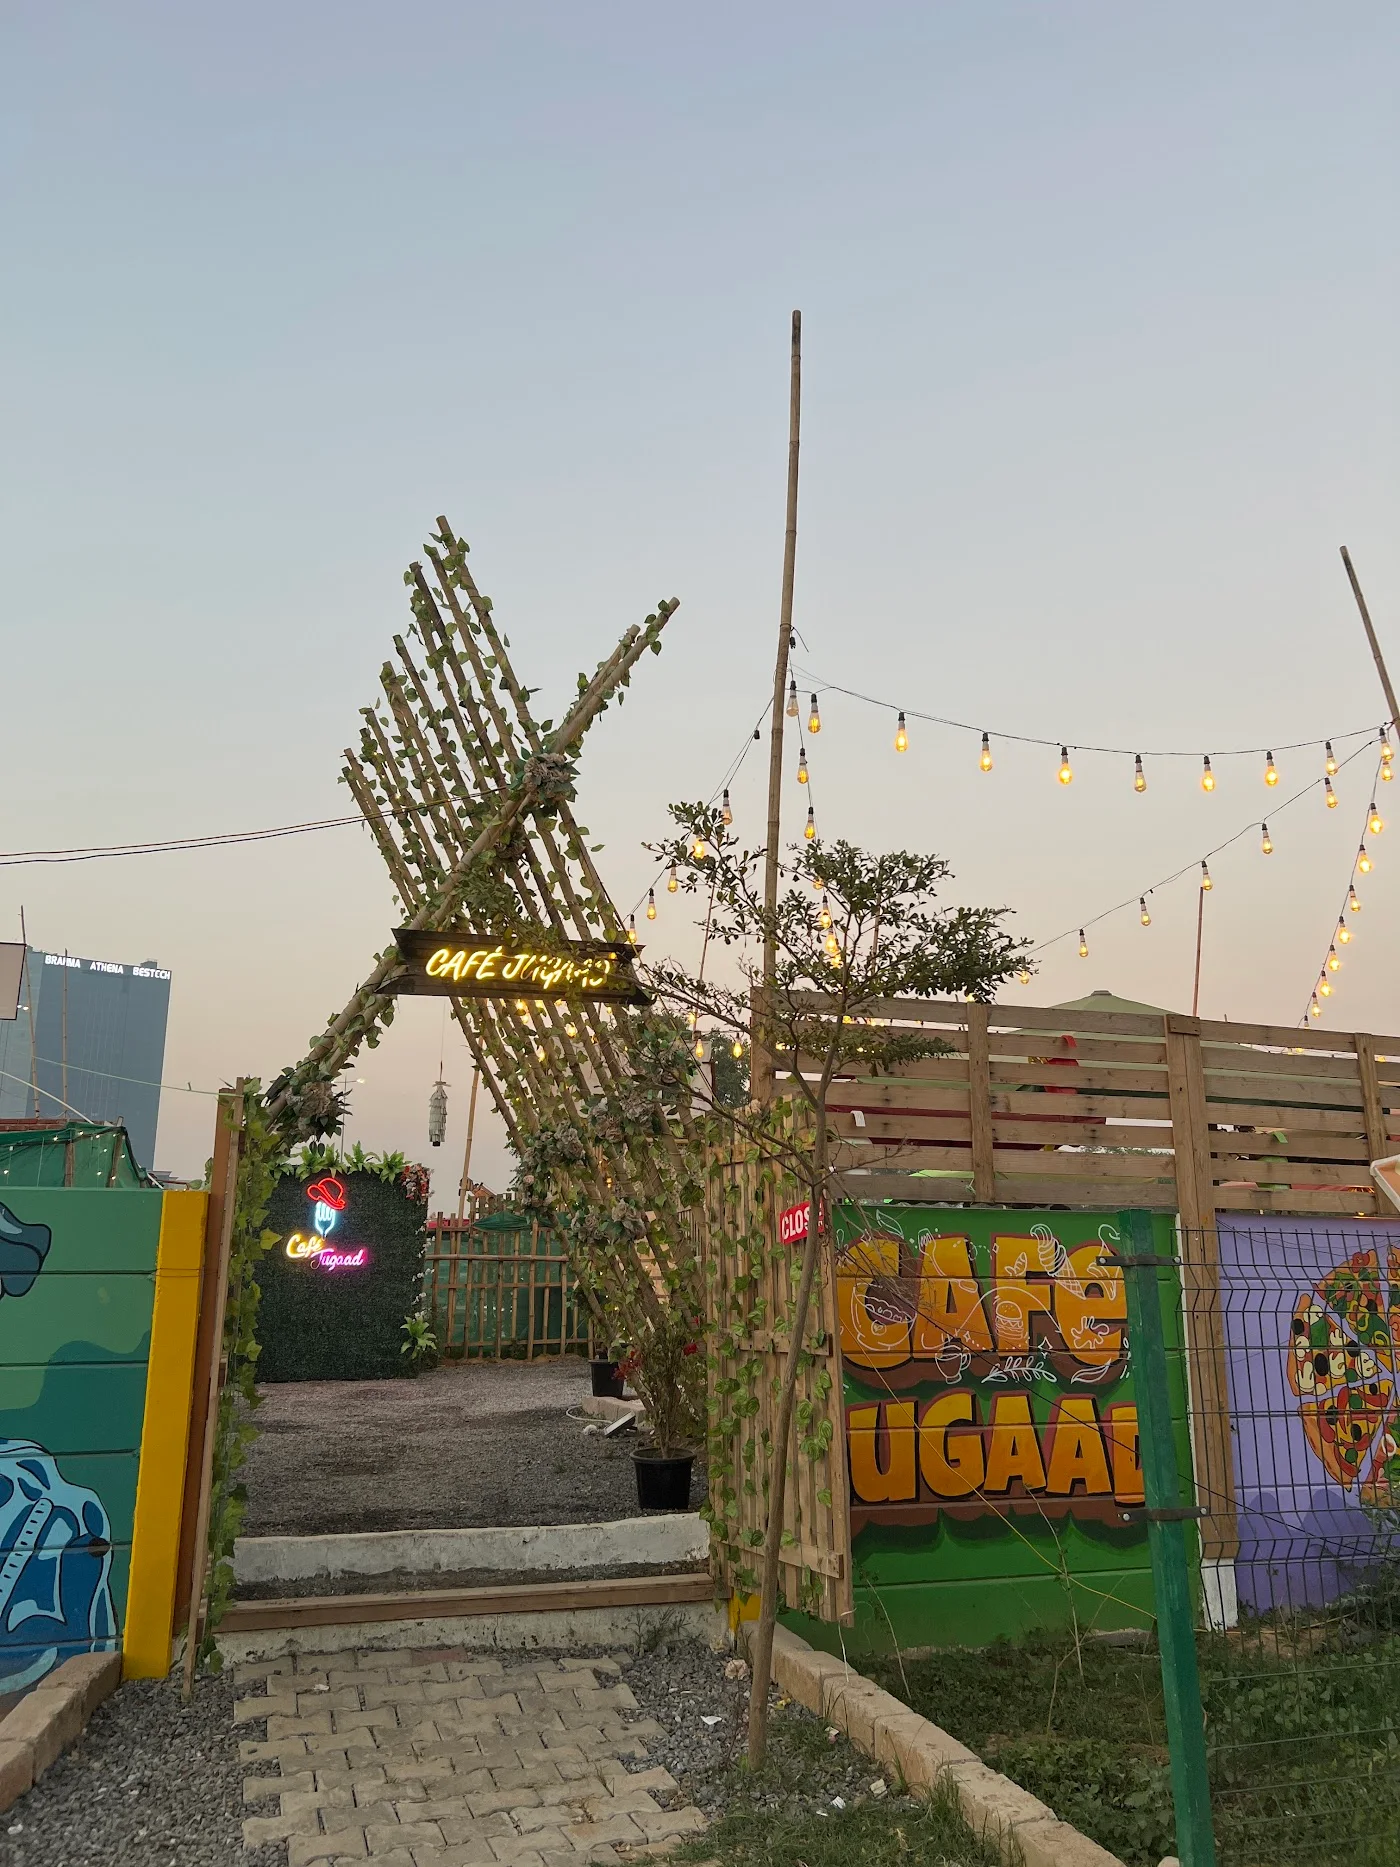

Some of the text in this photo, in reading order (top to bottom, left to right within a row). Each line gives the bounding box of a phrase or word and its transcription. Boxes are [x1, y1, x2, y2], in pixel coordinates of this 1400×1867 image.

[89, 961, 124, 974] ATHENA
[781, 1202, 823, 1240] CLOS
[309, 1247, 364, 1271] Jugaad
